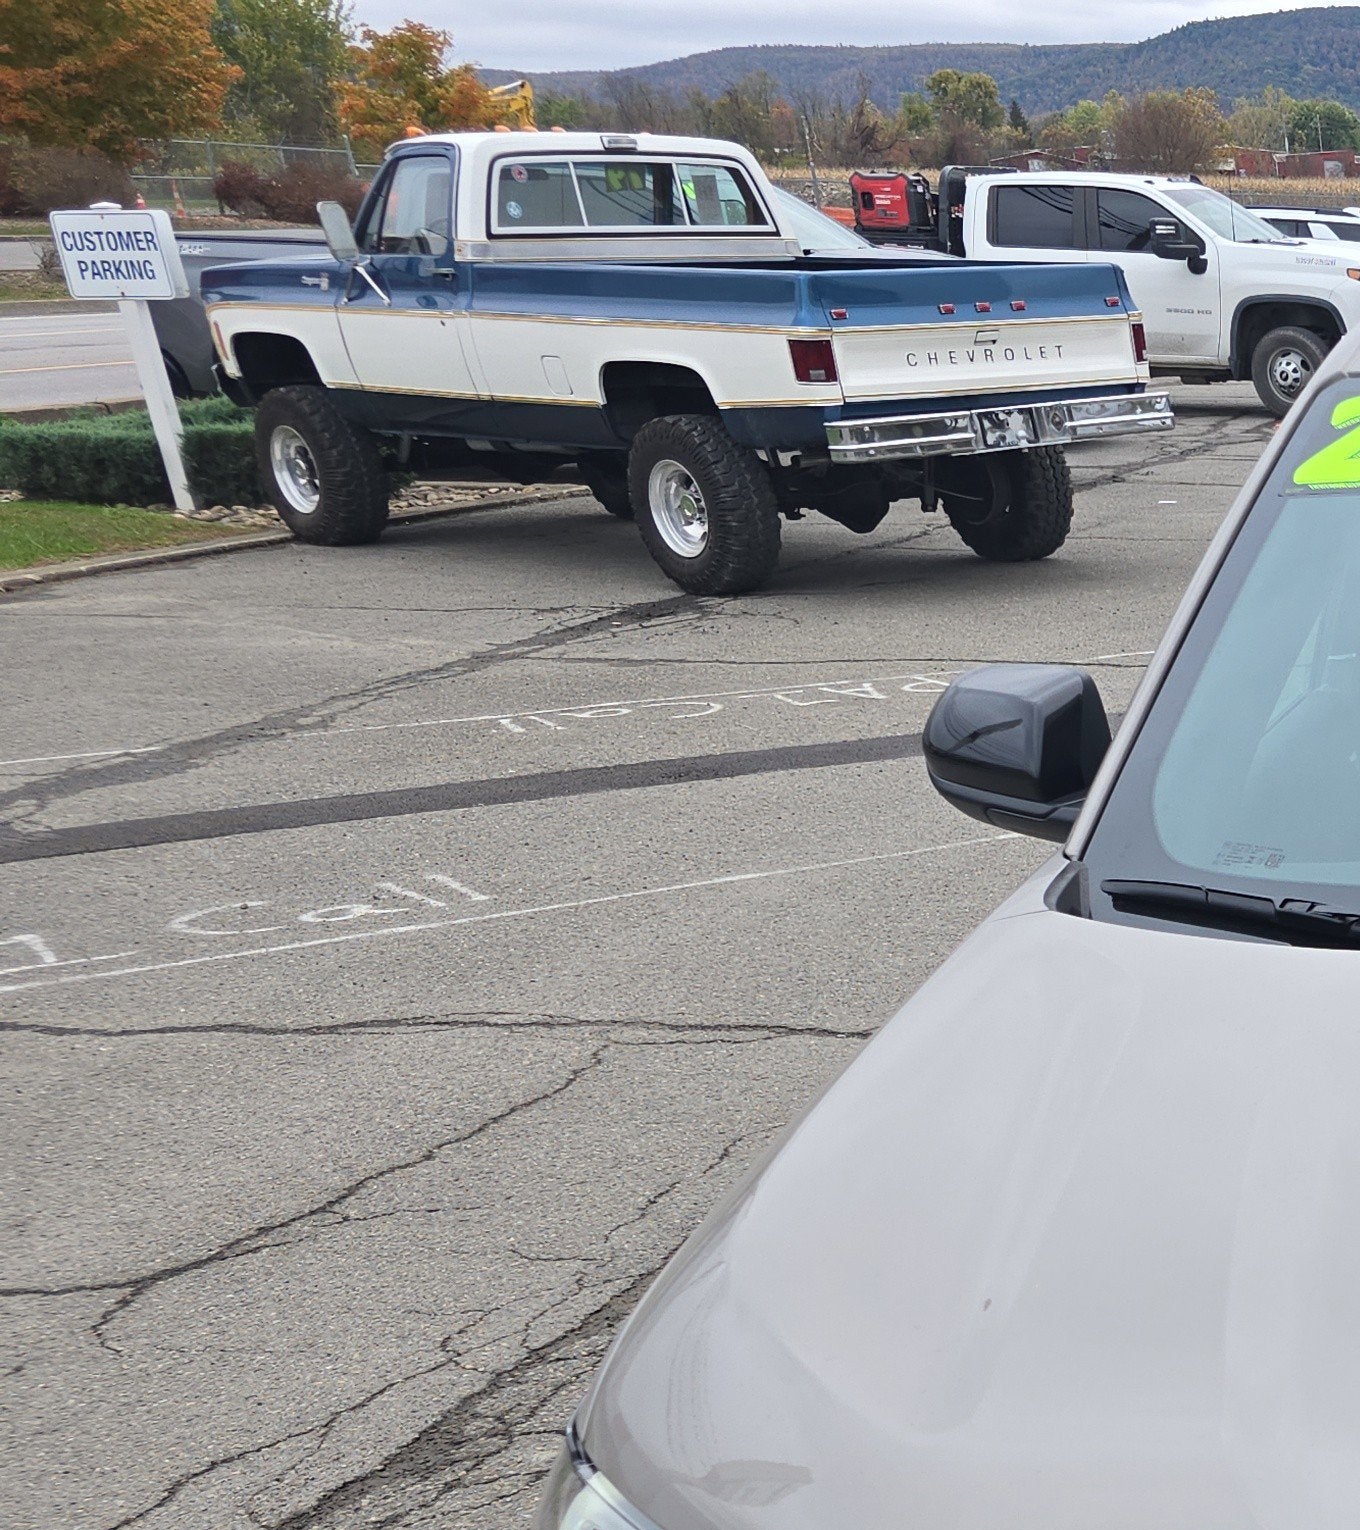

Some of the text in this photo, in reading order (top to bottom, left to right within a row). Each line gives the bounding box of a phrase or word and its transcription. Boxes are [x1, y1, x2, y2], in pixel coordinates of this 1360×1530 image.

[61, 231, 160, 252] CUSTOMER
[77, 259, 157, 280] PARKING
[906, 345, 1064, 367] CHEVROLET
